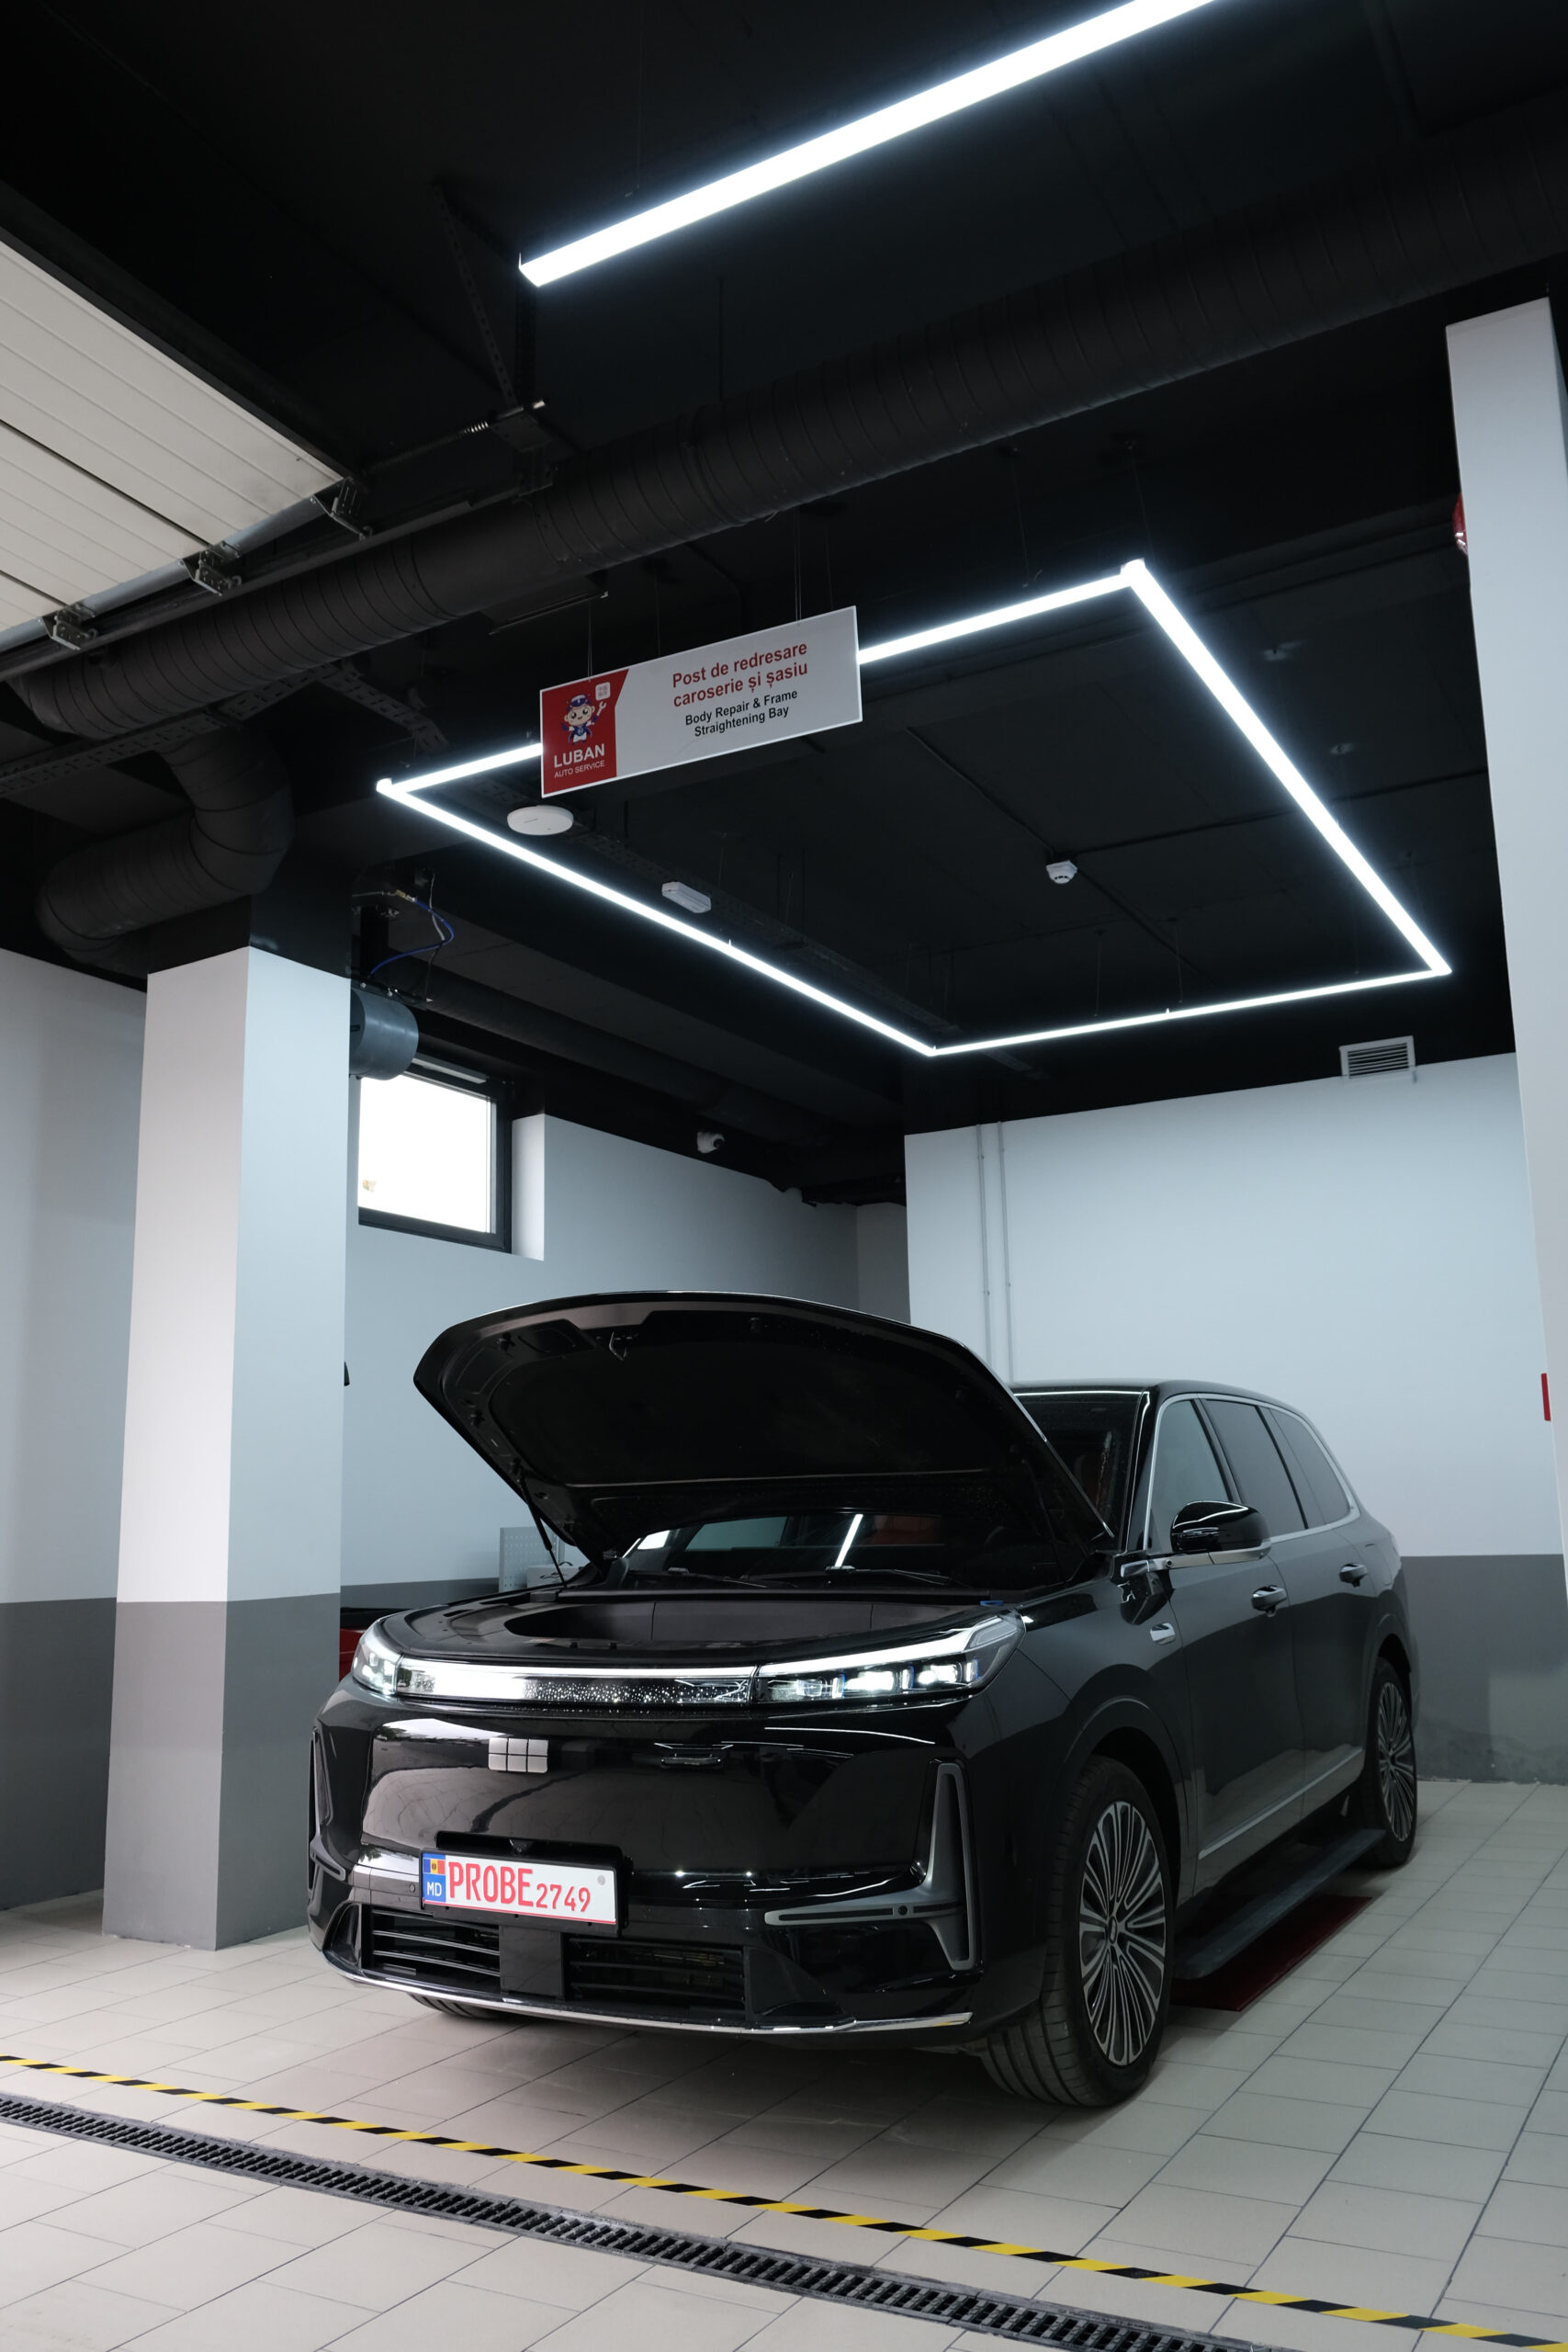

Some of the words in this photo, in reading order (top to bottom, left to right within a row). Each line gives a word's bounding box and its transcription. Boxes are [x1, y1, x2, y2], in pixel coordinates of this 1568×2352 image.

[672, 666, 706, 688] Post
[710, 662, 729, 678] de
[734, 643, 807, 673] redresare
[673, 678, 743, 707] caroserie
[748, 672, 761, 693] și
[766, 662, 808, 688] șasiu
[685, 711, 713, 726] Body
[716, 701, 750, 718] Repair
[752, 697, 761, 709] &
[763, 691, 798, 707] Frame
[694, 711, 766, 737] Straightening
[768, 706, 790, 719] Bay
[554, 743, 605, 768] LUBAN
[554, 767, 574, 778] AUTO
[574, 760, 605, 774] SERVICE
[426, 1881, 443, 1897] MD
